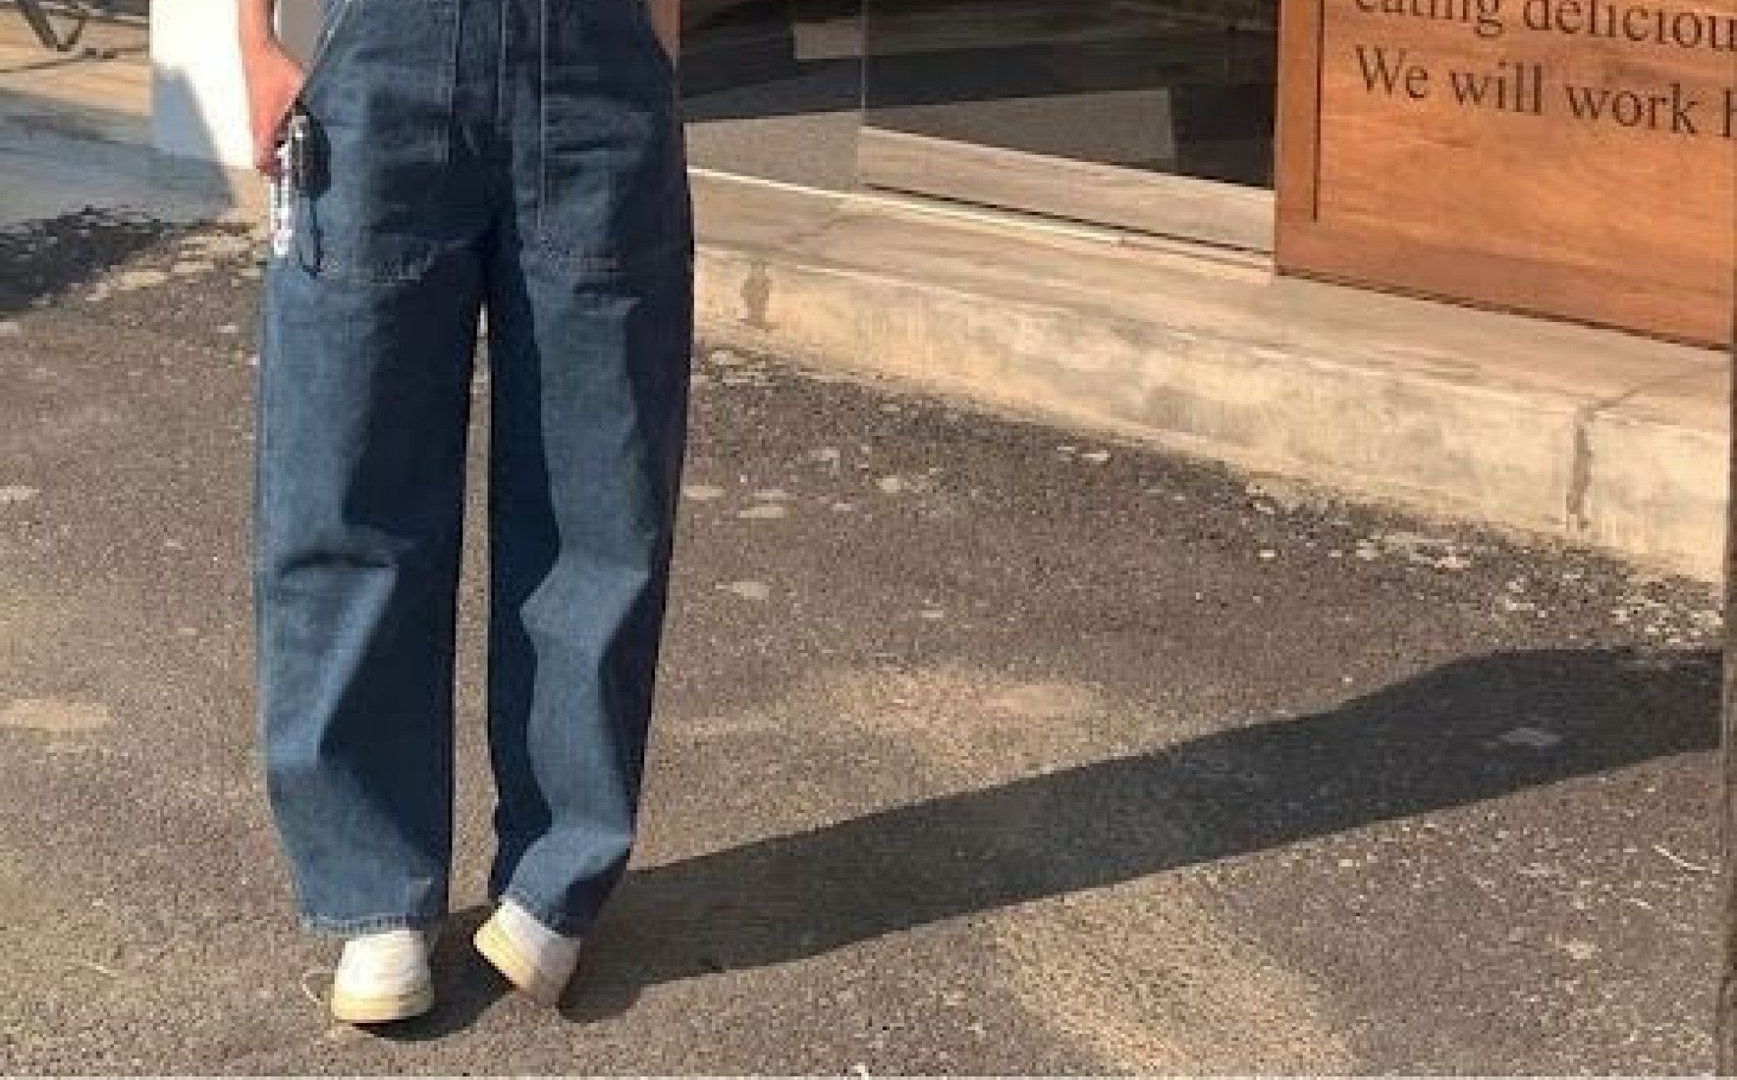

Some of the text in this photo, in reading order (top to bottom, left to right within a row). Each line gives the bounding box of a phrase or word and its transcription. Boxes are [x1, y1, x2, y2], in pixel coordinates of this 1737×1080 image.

[1355, 44, 1429, 100] We
[1449, 60, 1542, 117] will
[1565, 82, 1698, 135] work
